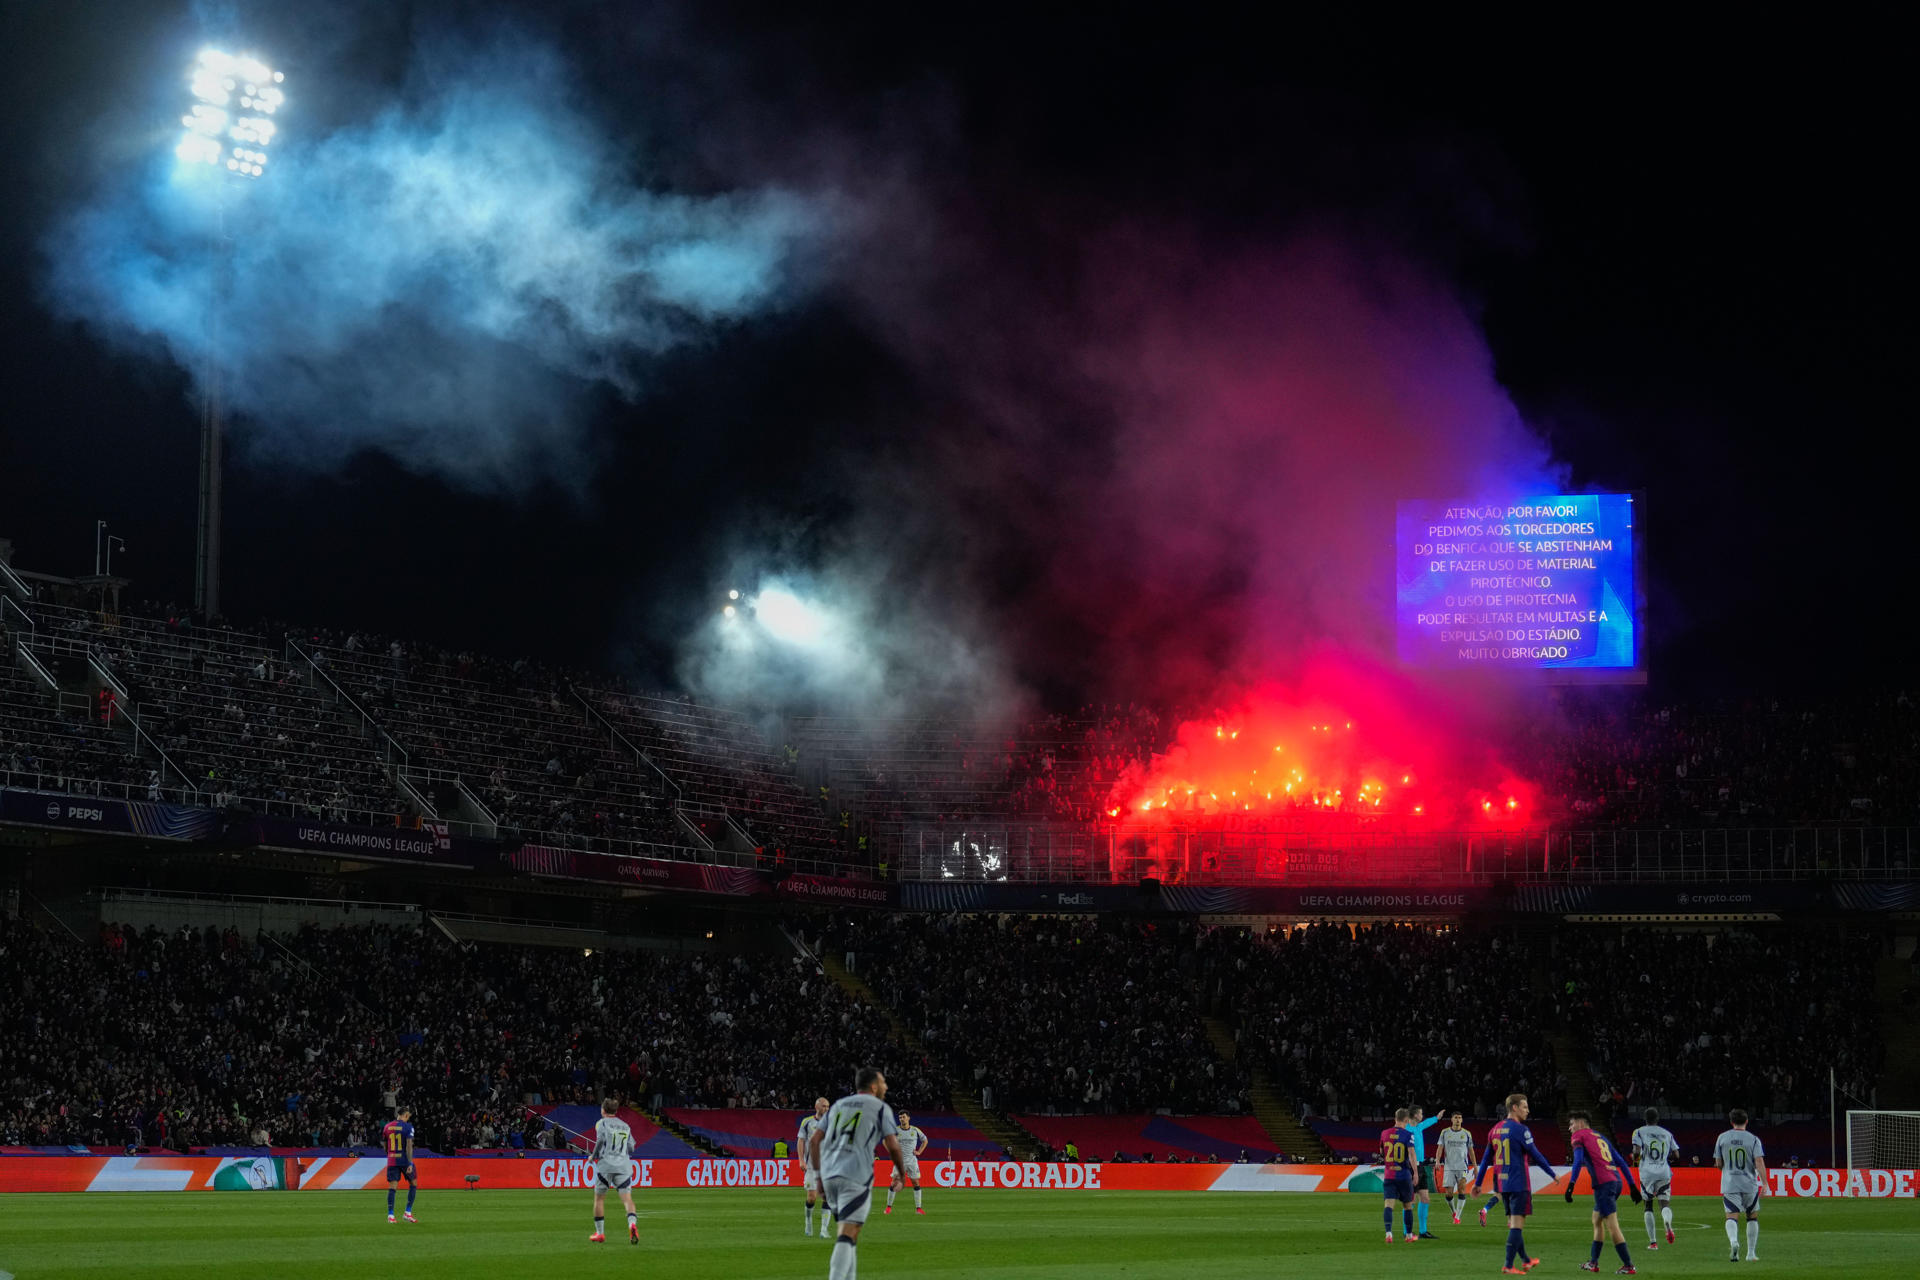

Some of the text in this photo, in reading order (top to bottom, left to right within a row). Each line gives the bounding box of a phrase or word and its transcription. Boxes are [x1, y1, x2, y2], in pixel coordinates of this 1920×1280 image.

[1445, 505, 1577, 521] ATENÇÃO, POR FAVOR!
[1429, 523, 1594, 537] PEDIMOS AOS TORCEDORES
[1415, 540, 1612, 555] DO BENFICA QUE SE ABSTENHAM
[1431, 558, 1596, 572] DE FAZER USO DE MATERIAL
[1445, 594, 1576, 607] O USO DE PIROTECNIA
[1418, 611, 1608, 625] PODE RESULTAR EM MULTAS E A
[1507, 629, 1525, 641] DO
[1529, 626, 1581, 640] ESTÁDIO.
[1459, 647, 1567, 660] MUITO OBRIGADO
[68, 806, 103, 821] PEPSI
[298, 827, 434, 854] UEFA CHAMPIONS LEAGUE
[617, 864, 670, 879] QATAR AIRWAYS
[788, 881, 887, 901] UEFA CHAMPIONS LEAGUE
[1058, 892, 1096, 905] FedEx
[1692, 894, 1752, 904] crypto.com
[1299, 895, 1465, 906] UEFA CHAMPIONS LEAGUE
[832, 1110, 862, 1145] 14
[389, 1133, 403, 1151] 11
[611, 1131, 628, 1153] 17
[1597, 1138, 1613, 1162] 8
[1649, 1140, 1665, 1160] 61
[1384, 1141, 1405, 1163] 20
[1492, 1138, 1511, 1165] 21
[1728, 1148, 1746, 1170] 10
[540, 1159, 653, 1187] GATODE
[686, 1159, 790, 1186] GATORADE
[934, 1161, 1101, 1189] GATORADE
[1755, 1168, 1915, 1198] ATORADE
